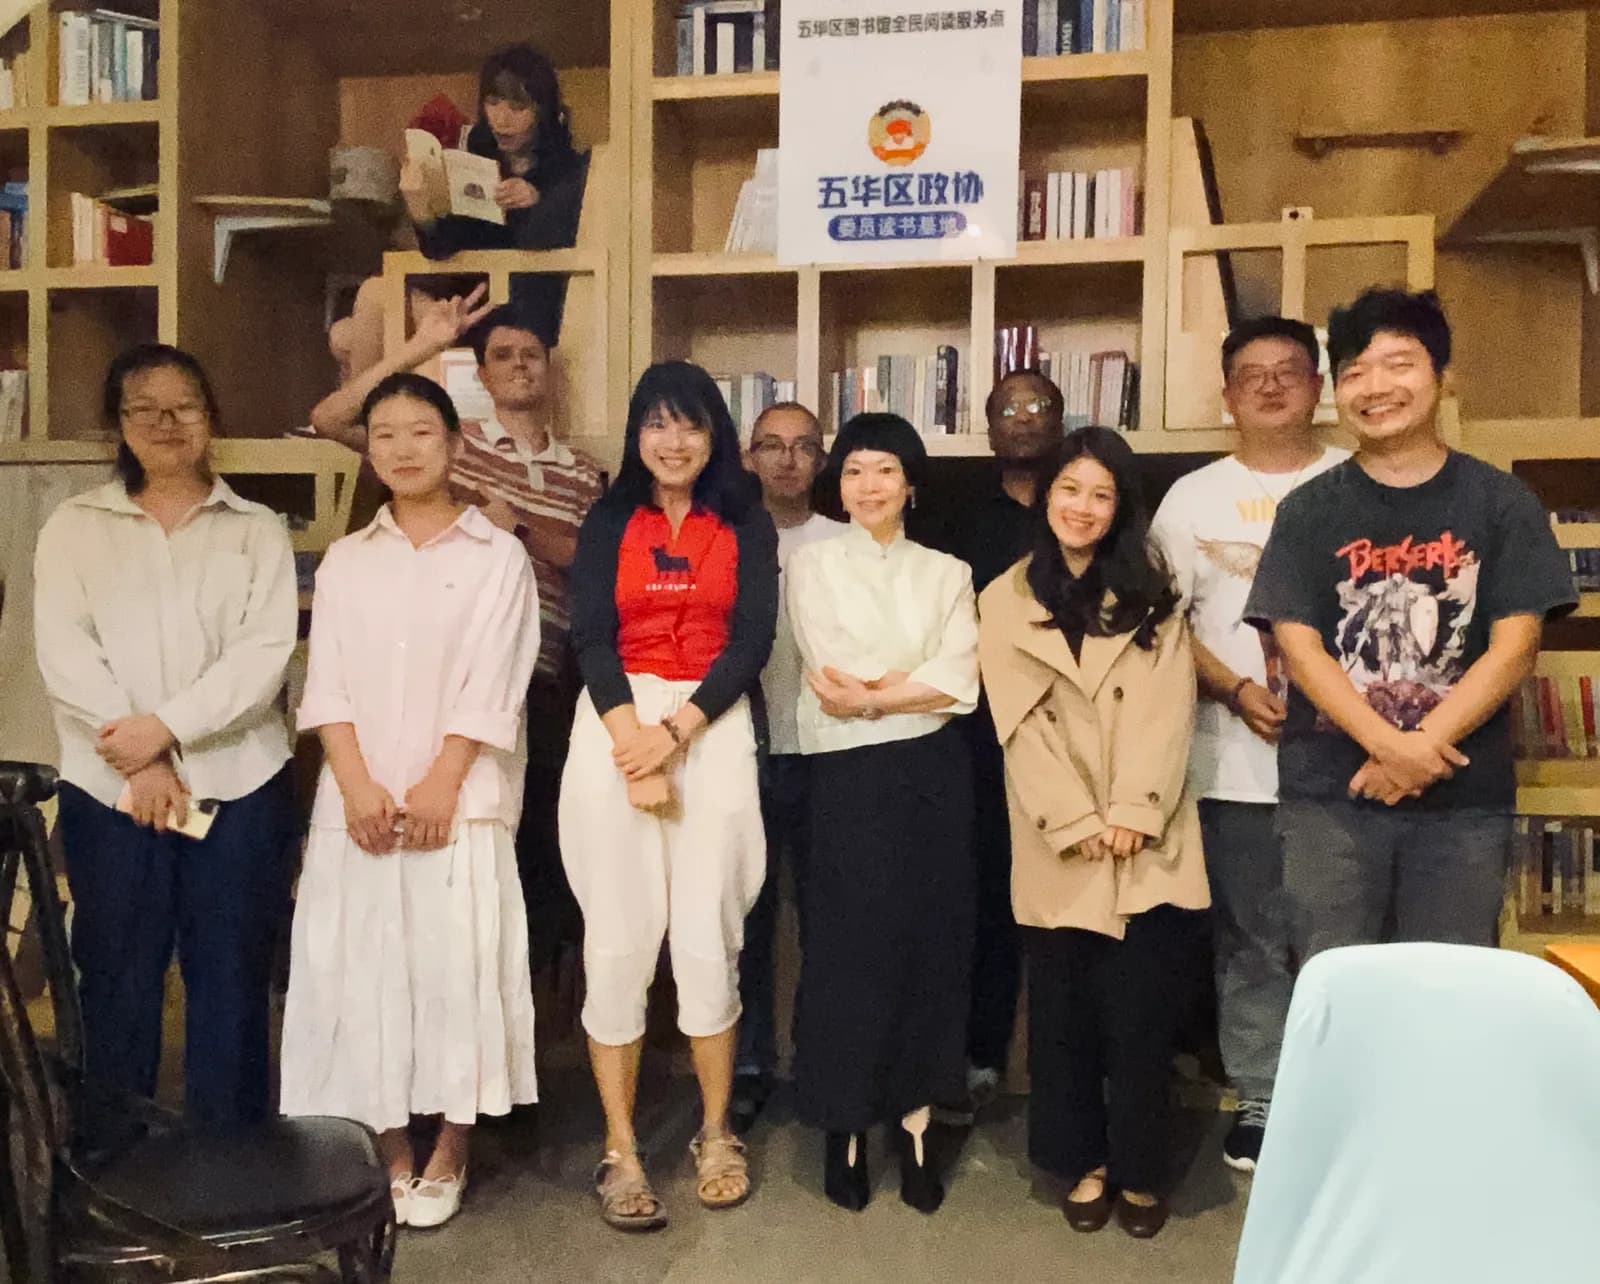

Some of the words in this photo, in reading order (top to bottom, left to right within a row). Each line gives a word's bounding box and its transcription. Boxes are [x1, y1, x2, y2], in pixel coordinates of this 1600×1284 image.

[798, 10, 1005, 38] 五华区图书馆全民阅读服务点
[817, 170, 984, 208] 五华区政协
[1335, 530, 1465, 580] BERSERK
